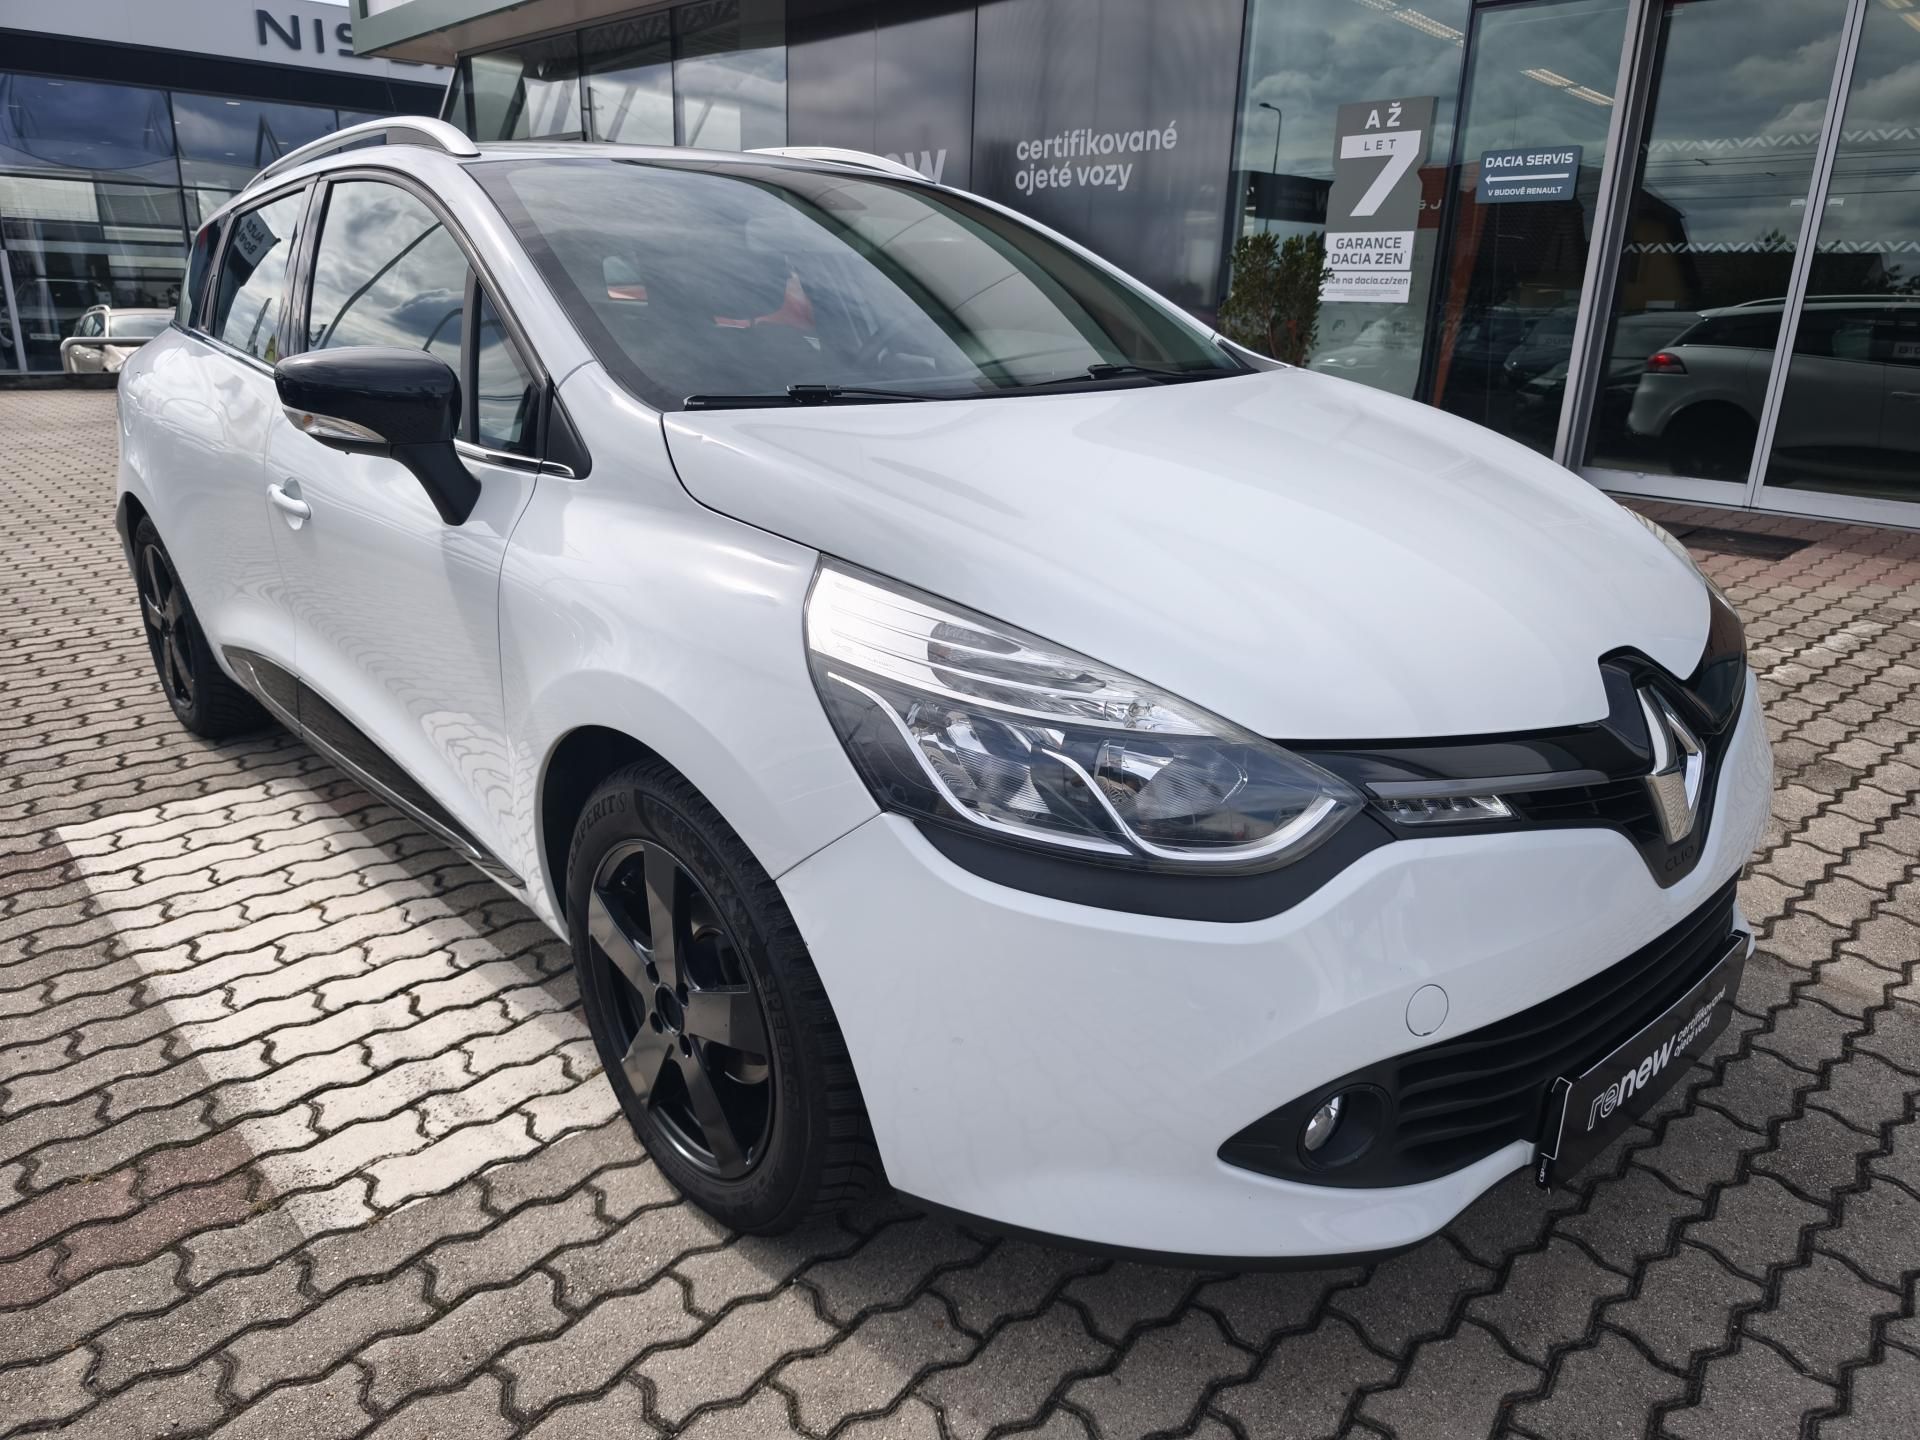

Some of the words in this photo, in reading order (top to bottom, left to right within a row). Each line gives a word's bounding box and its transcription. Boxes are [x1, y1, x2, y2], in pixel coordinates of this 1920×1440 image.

[1364, 102, 1402, 129] AŽ
[1016, 120, 1178, 161] certifikované
[1364, 138, 1397, 151] LET
[1485, 156, 1523, 169] DACIA
[1526, 152, 1574, 167] SERVIS
[1015, 161, 1073, 196] ojeté
[1076, 162, 1133, 192] vozy
[1340, 130, 1422, 217] 7
[1488, 189, 1494, 197] V
[1494, 186, 1526, 196] BUDOVĚ
[1526, 186, 1562, 195] RENAULT
[1335, 236, 1402, 250] GARANCE
[1331, 253, 1372, 266] DACIA
[1374, 252, 1404, 265] ZEN
[1342, 277, 1353, 285] na
[1354, 276, 1409, 285] dacia.cz/zen
[1664, 844, 1695, 872] CLIO
[1587, 1034, 1676, 1131] renew
